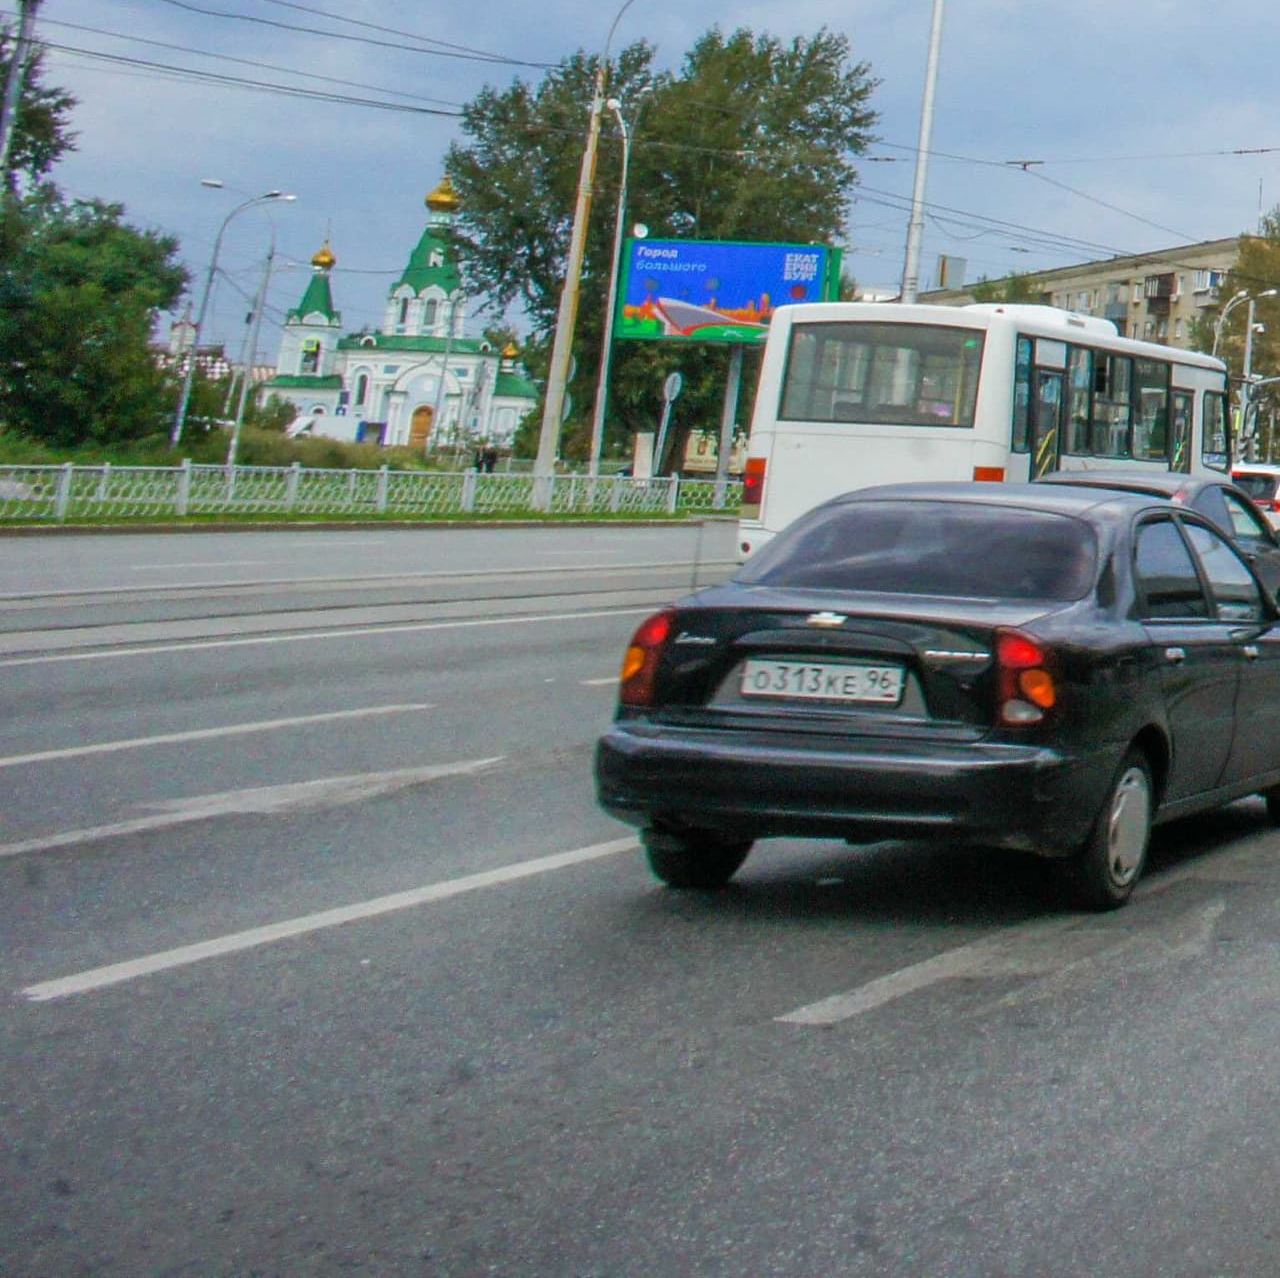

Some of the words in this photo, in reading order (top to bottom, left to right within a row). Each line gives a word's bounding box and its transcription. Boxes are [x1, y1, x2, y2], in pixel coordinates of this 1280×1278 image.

[637, 246, 678, 259] Город
[755, 666, 856, 695] О313КЕ
[869, 670, 893, 689] 96
